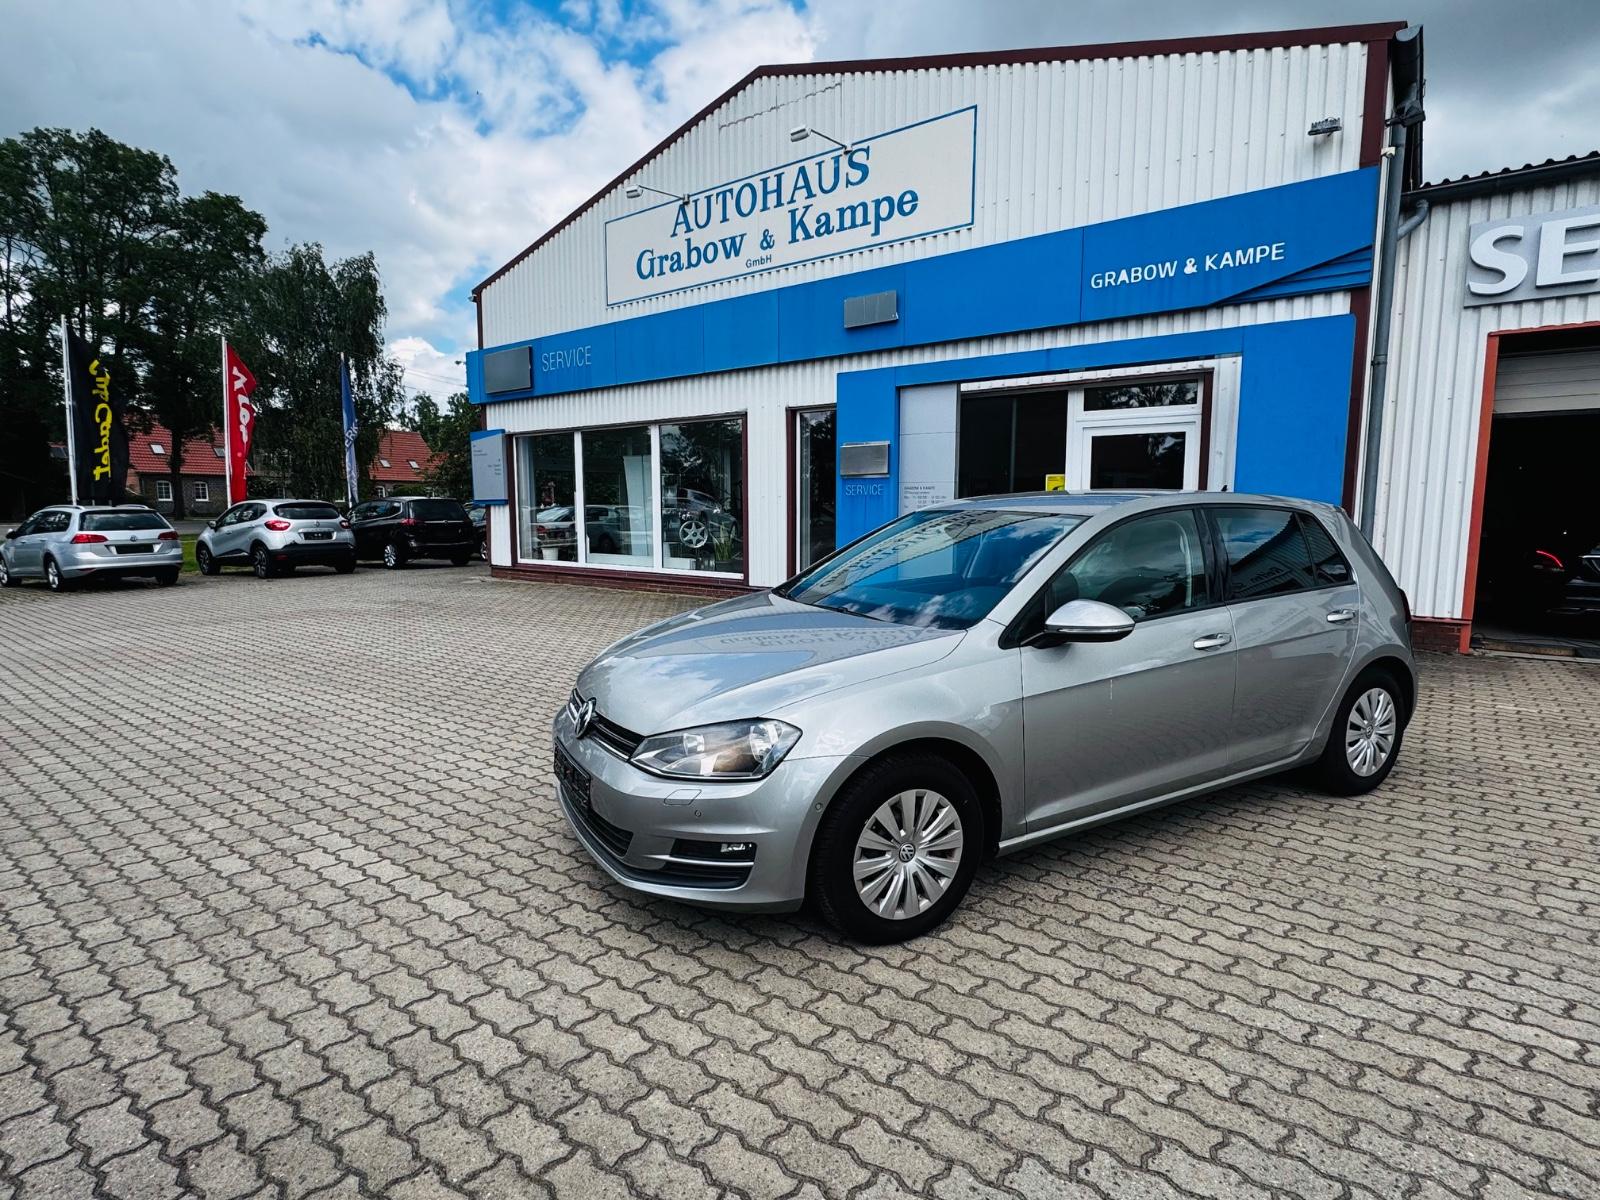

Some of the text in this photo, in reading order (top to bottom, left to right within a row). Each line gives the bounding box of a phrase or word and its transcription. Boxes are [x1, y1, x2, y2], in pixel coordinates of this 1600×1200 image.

[670, 145, 870, 238] AUTOHAUS
[636, 188, 919, 280] Grabow & Kampe
[745, 255, 772, 269] GmbH
[1091, 242, 1285, 289] GRABOW & KAMPE
[542, 346, 592, 370] SERVICE
[845, 484, 882, 496] SERVICE
